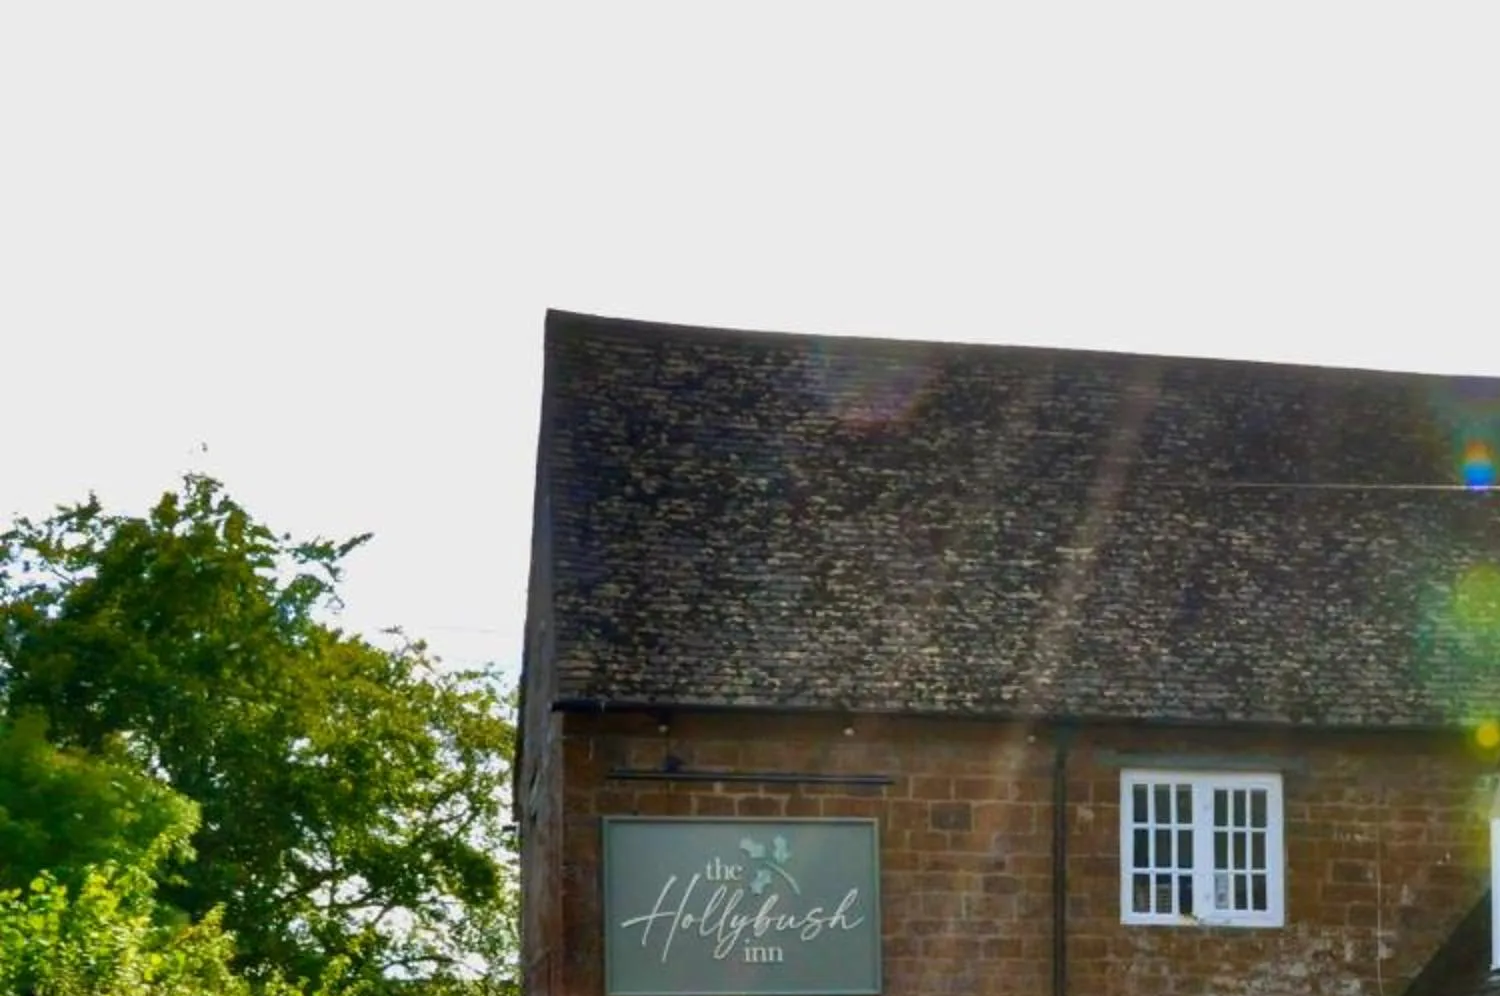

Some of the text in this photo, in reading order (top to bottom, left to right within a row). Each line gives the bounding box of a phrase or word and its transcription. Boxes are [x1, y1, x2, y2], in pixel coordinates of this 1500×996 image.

[706, 857, 743, 881] the
[620, 873, 865, 963] Hollybush
[744, 939, 784, 963] inn
